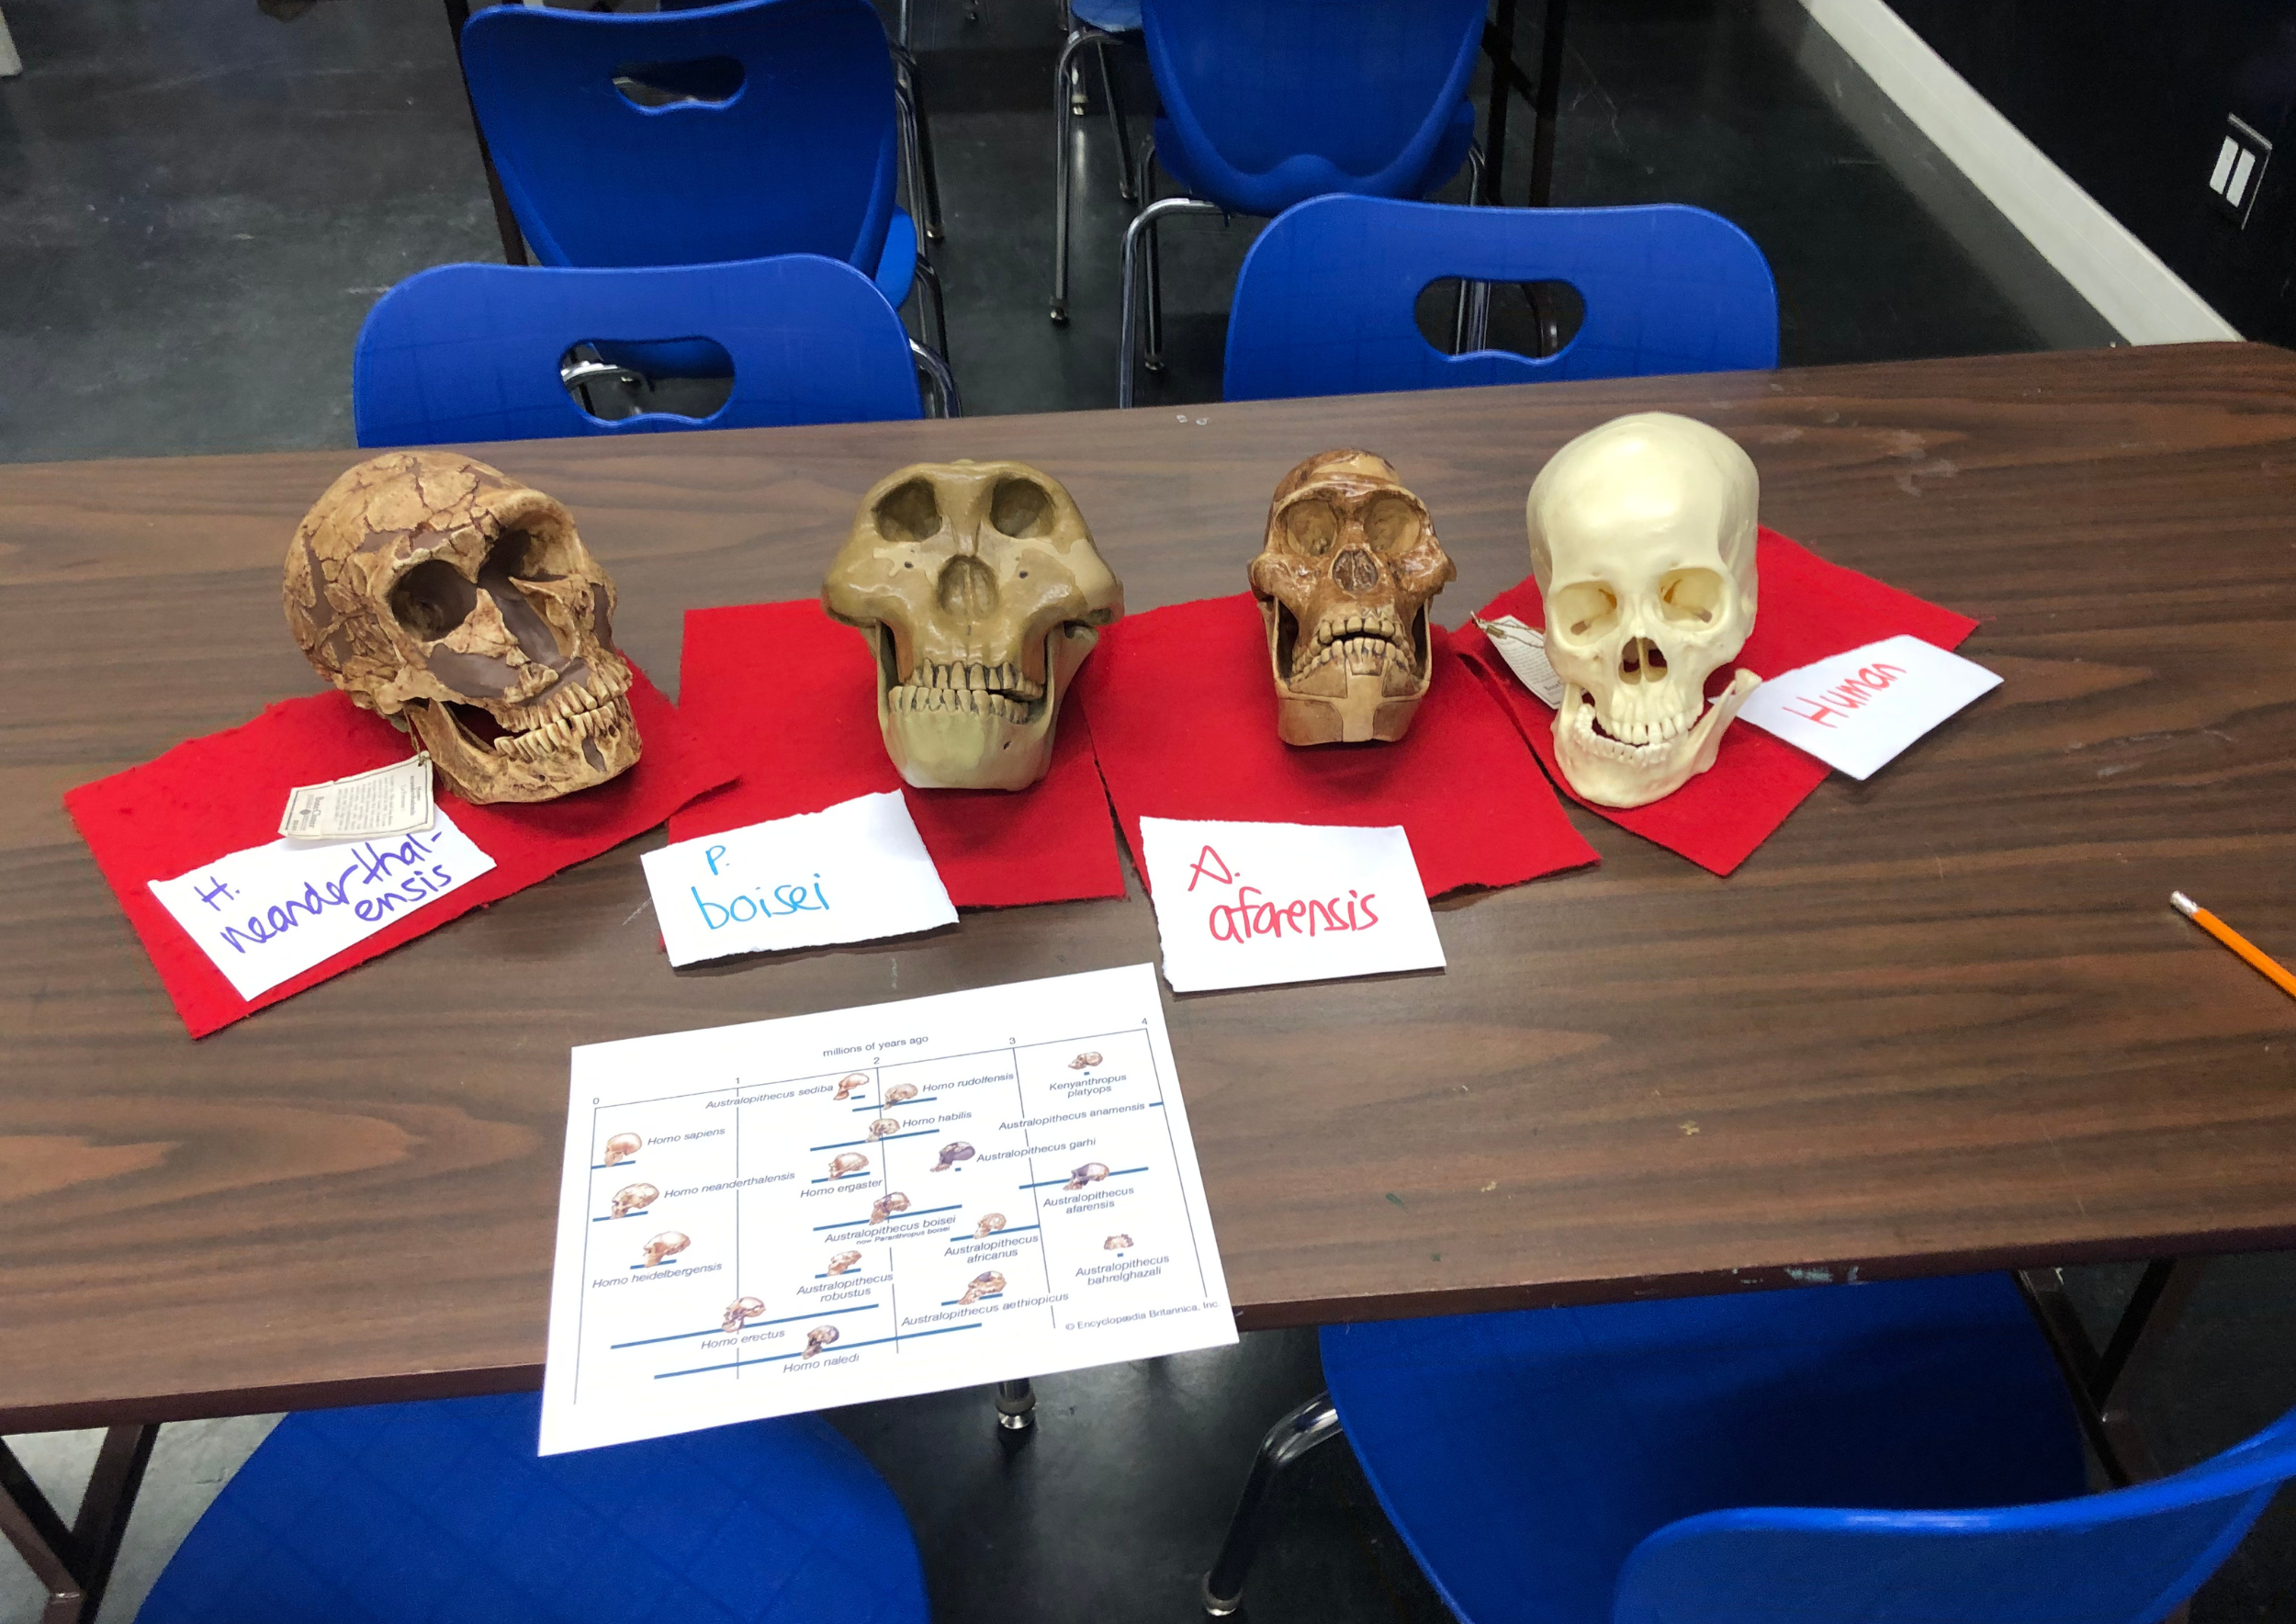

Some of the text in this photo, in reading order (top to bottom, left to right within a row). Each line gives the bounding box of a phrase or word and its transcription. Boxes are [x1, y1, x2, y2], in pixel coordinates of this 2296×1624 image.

[1782, 663, 1908, 728] Human
[704, 845, 731, 875] P.
[1187, 845, 1241, 892] A.
[194, 876, 241, 911] H.
[219, 831, 443, 953] neanderthal-
[355, 864, 453, 921] ensis
[691, 873, 830, 930] boisei
[1209, 886, 1379, 944] afarensis
[822, 1035, 929, 1057] millions of years ago
[736, 1077, 740, 1085] 1
[922, 1072, 1015, 1092] Homo rudolfensis
[1049, 1073, 1127, 1091] Kenyanthropus
[1067, 1084, 1112, 1099] platyops
[705, 1084, 834, 1109] Australopithecus sediba
[902, 1110, 972, 1128] Homo habilis
[998, 1101, 1146, 1131] Australopithecus anamensis
[647, 1127, 726, 1145] Homo sapiens
[976, 1137, 1097, 1163] Australopithecus garhi
[664, 1171, 795, 1199] Homo neanderthalensis
[800, 1178, 884, 1198] Homo ergaster
[1043, 1186, 1134, 1207] Australopithecus
[1065, 1199, 1116, 1215] afarensis
[825, 1214, 956, 1243] Australopithecus boisei
[874, 1230, 926, 1243] Paranthropus
[928, 1226, 951, 1235] boisei
[944, 1234, 1039, 1257] Australopithecus
[967, 1247, 1019, 1264] africanus
[592, 1262, 723, 1289] Homo heidelbergensis
[1075, 1256, 1170, 1277] Australopithecus
[1087, 1266, 1162, 1286] bahrelghazali
[796, 1272, 894, 1295] Australopithecus
[819, 1288, 872, 1303] robustus
[1202, 1300, 1221, 1310] Inc.
[901, 1291, 1069, 1326] Australopithecus aethiopicus
[701, 1329, 785, 1349] Homo erectus
[783, 1353, 861, 1373] Homo naledi
